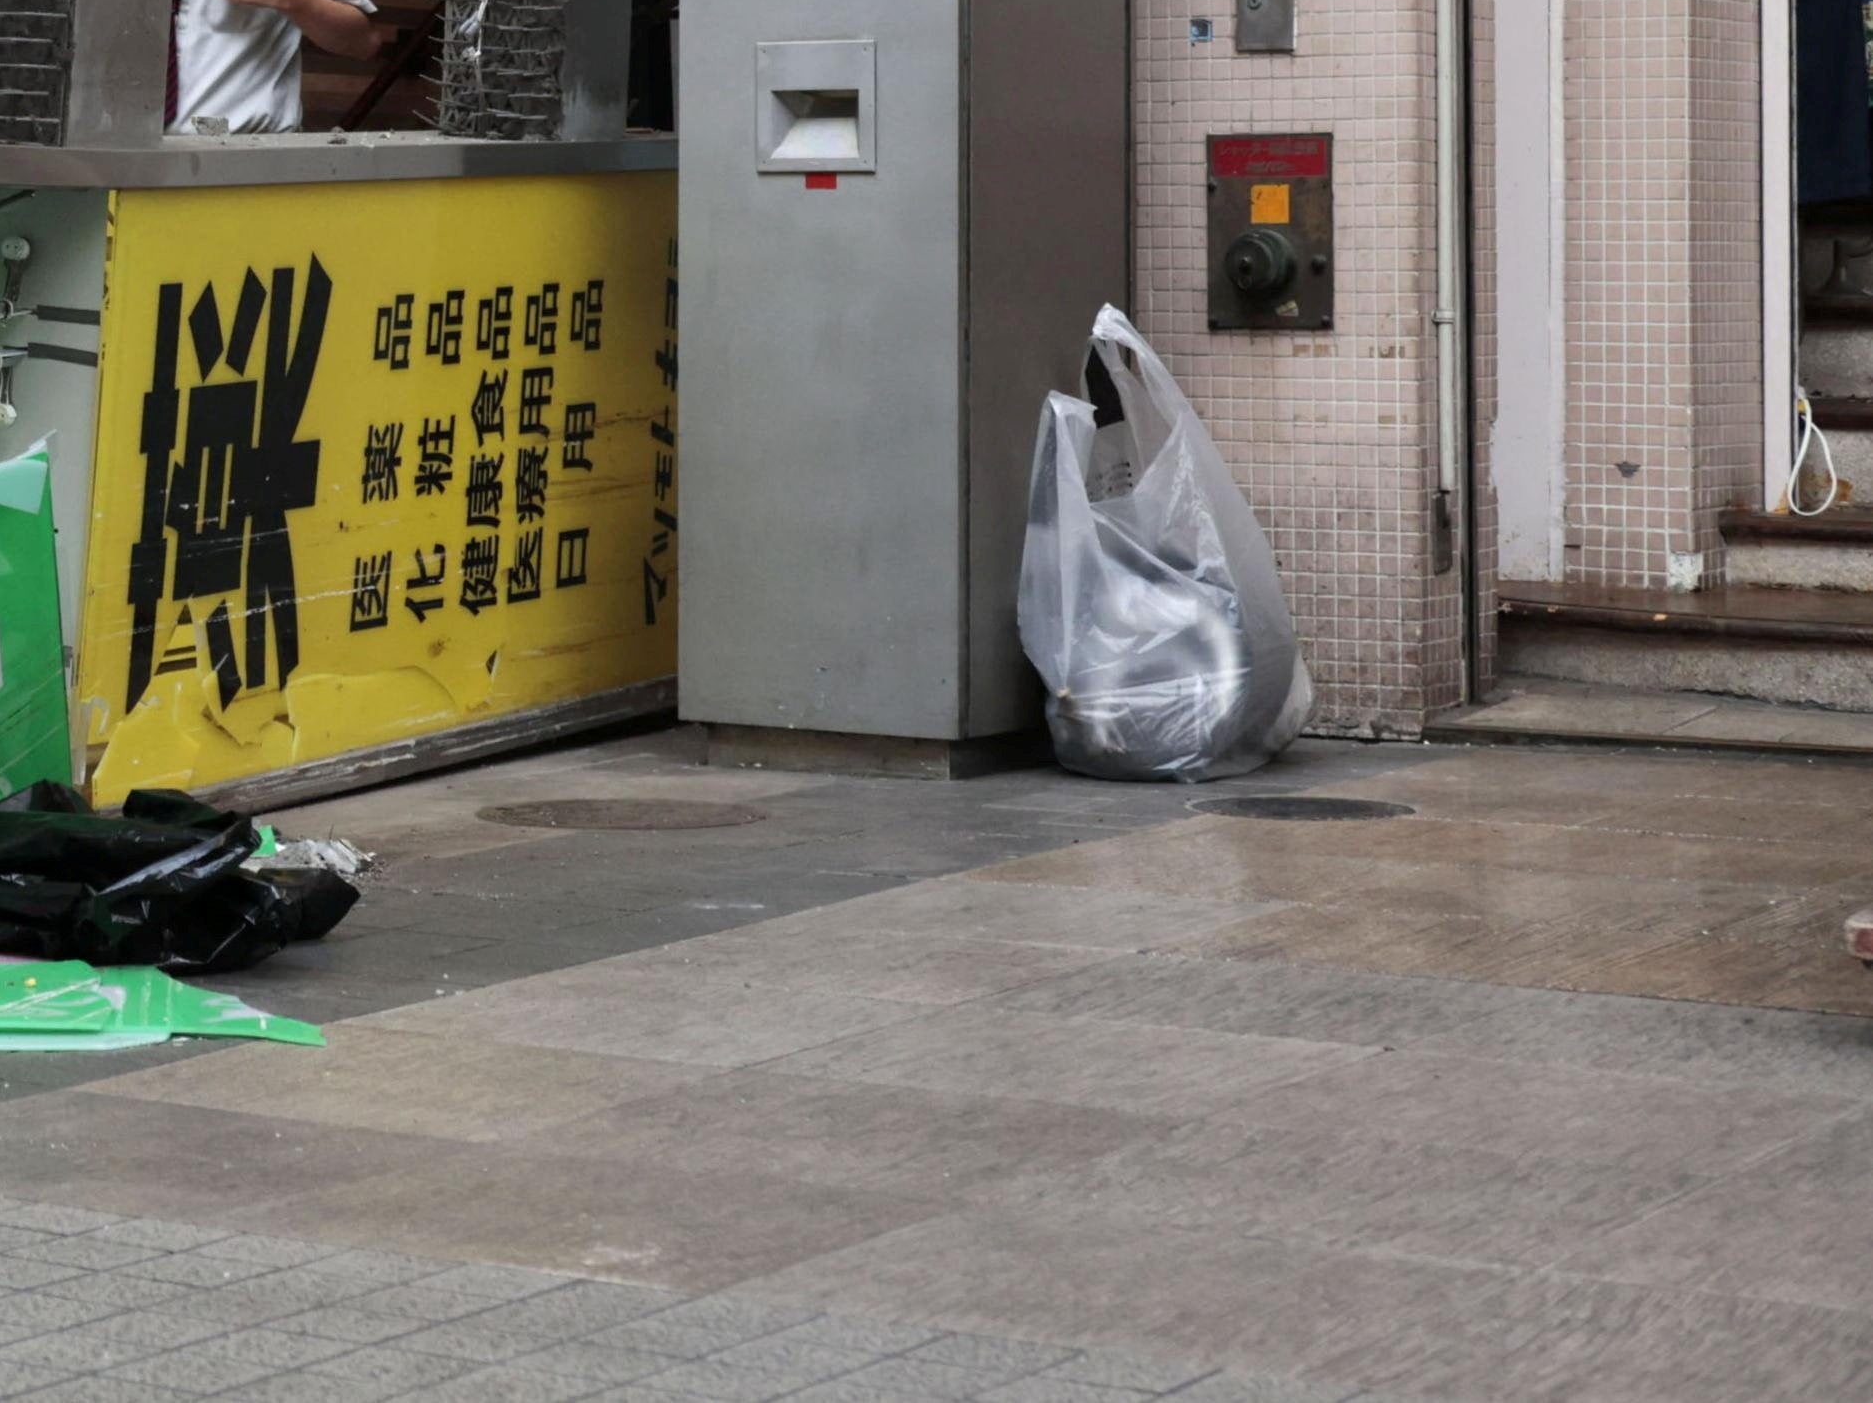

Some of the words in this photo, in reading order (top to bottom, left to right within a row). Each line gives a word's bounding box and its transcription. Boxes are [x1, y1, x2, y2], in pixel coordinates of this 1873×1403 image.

[125, 251, 334, 716] 薬
[349, 294, 415, 633] 医薬品
[405, 290, 465, 624] 化粧品
[459, 286, 514, 617] 健康食品
[507, 282, 560, 605] 医療用品
[556, 278, 605, 589] 日用品
